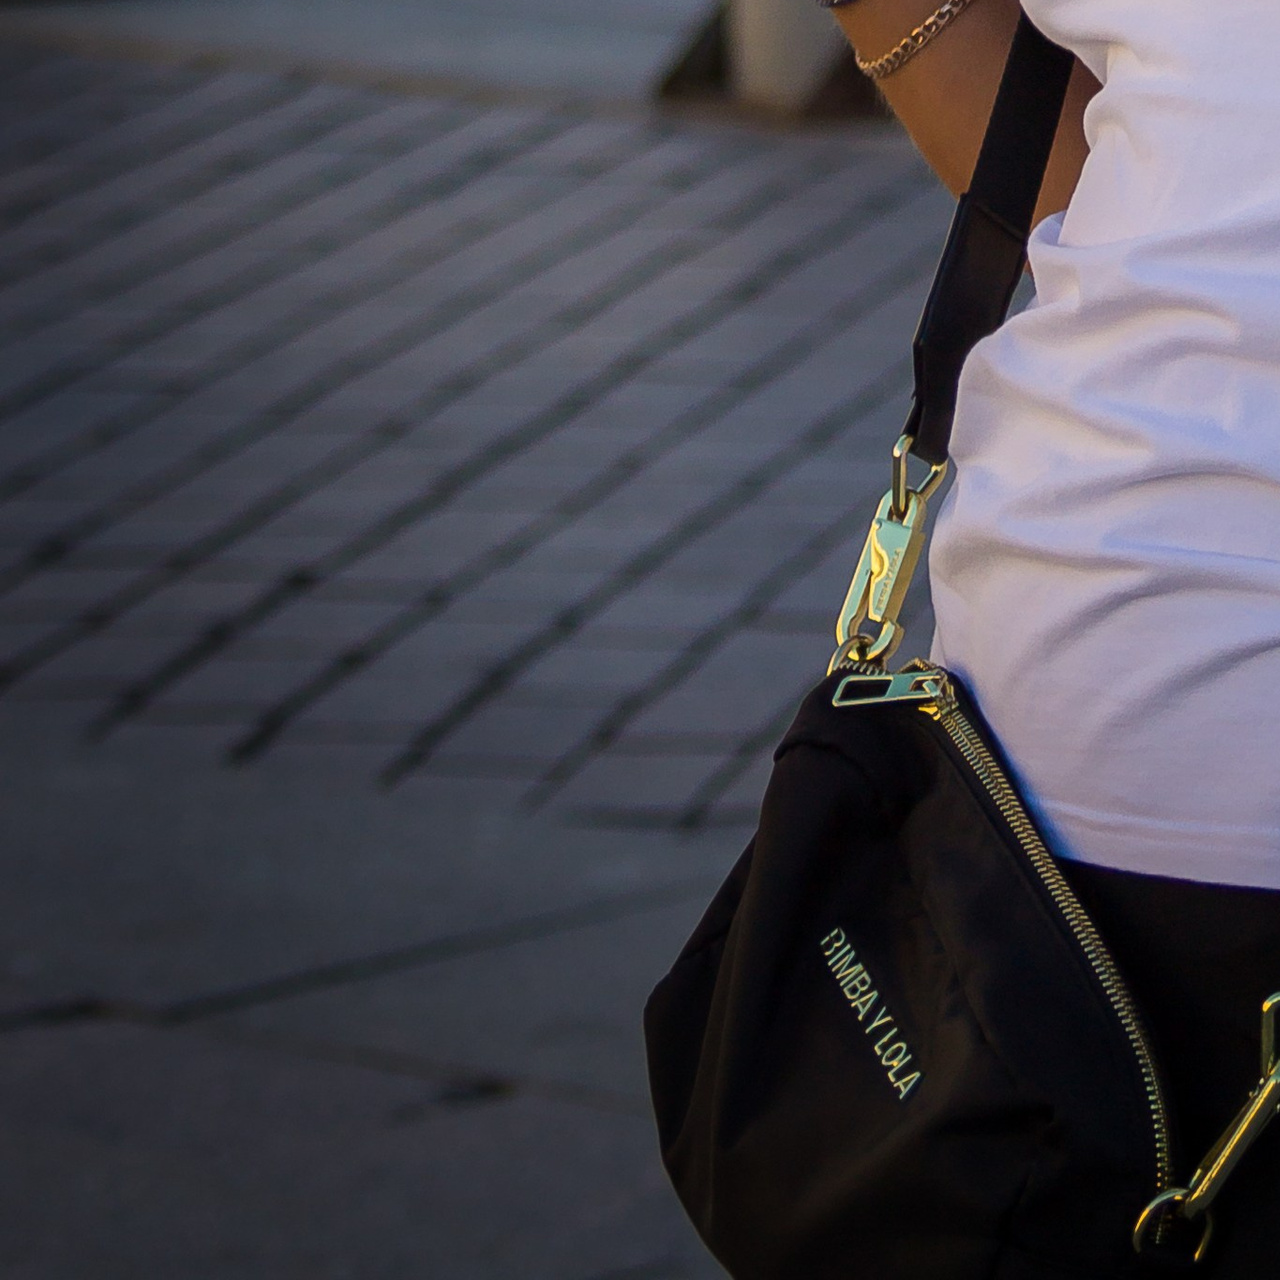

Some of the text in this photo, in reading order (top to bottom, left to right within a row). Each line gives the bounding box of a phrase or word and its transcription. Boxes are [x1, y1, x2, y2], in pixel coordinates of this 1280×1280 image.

[820, 927, 921, 1100] BIMBA Y LOLA
